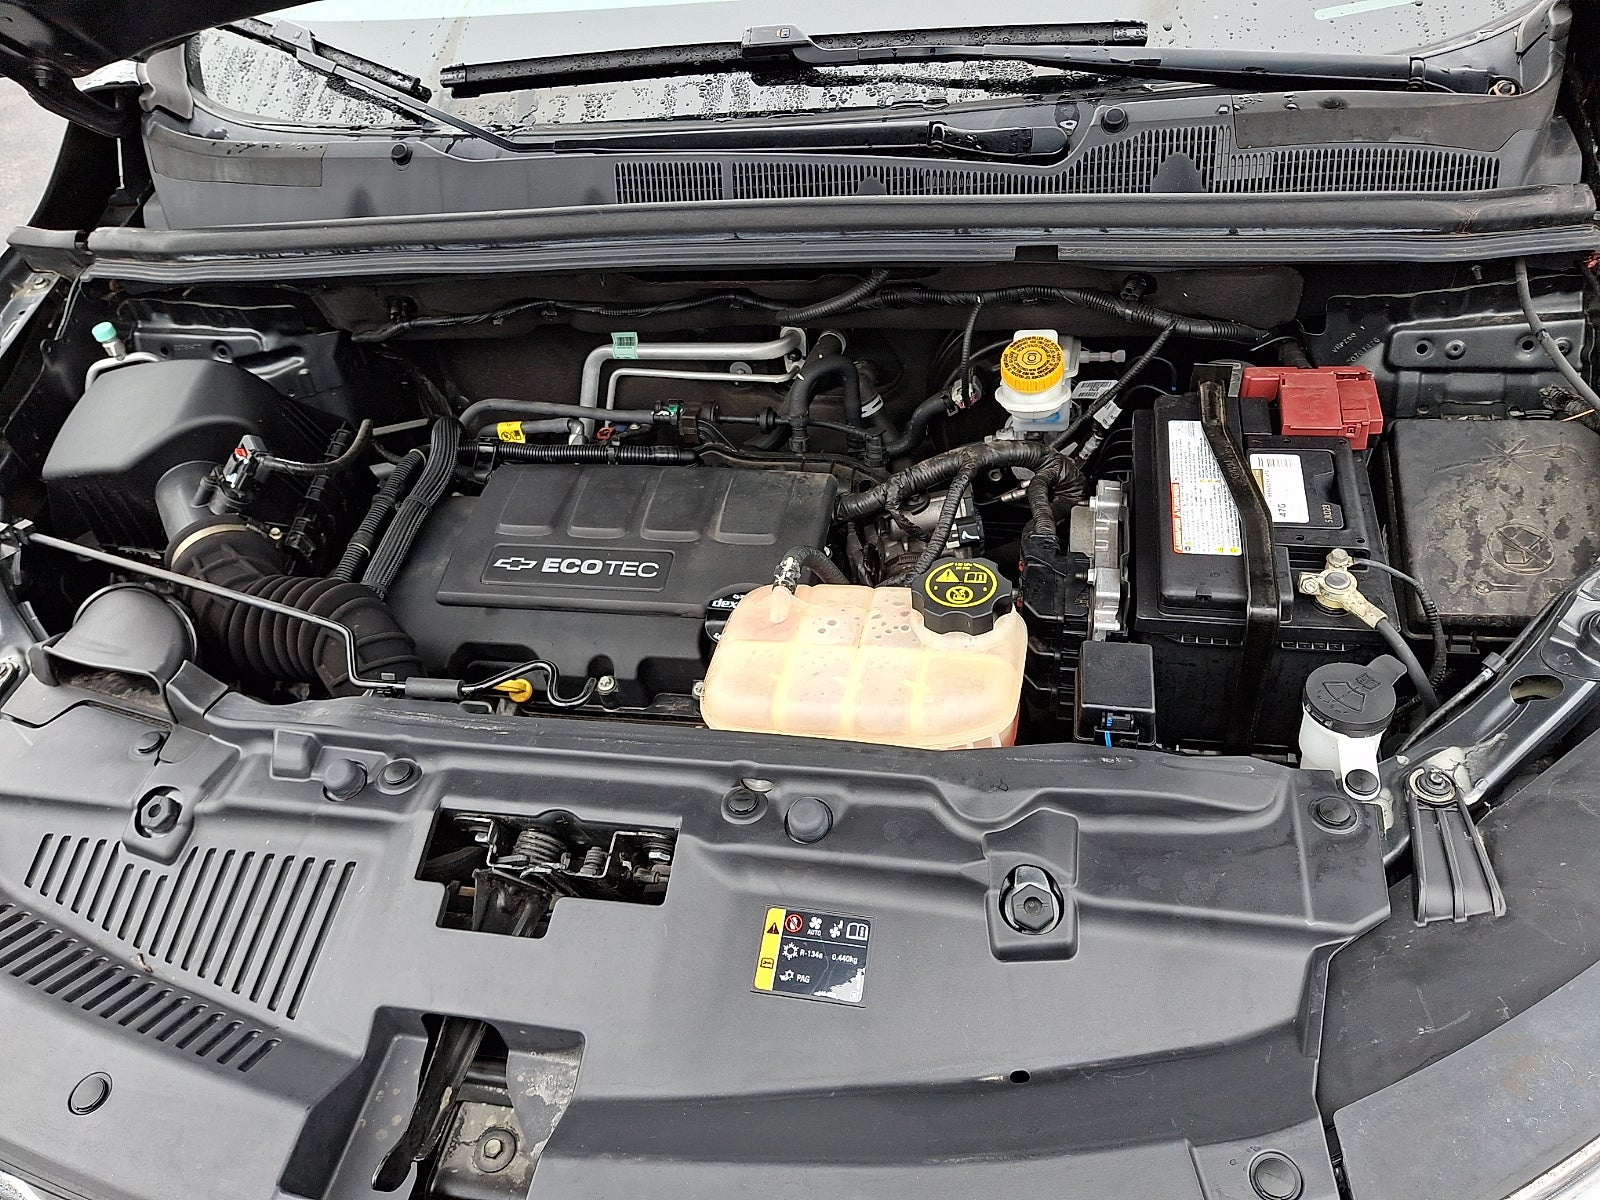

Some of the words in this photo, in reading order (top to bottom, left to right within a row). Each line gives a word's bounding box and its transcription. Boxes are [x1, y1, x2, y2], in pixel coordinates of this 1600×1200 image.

[541, 557, 660, 578] ECOTEC
[806, 929, 822, 937] AUTO
[799, 948, 823, 960] R-134a
[831, 953, 859, 965] 0.440kg
[796, 974, 811, 984] PAG
